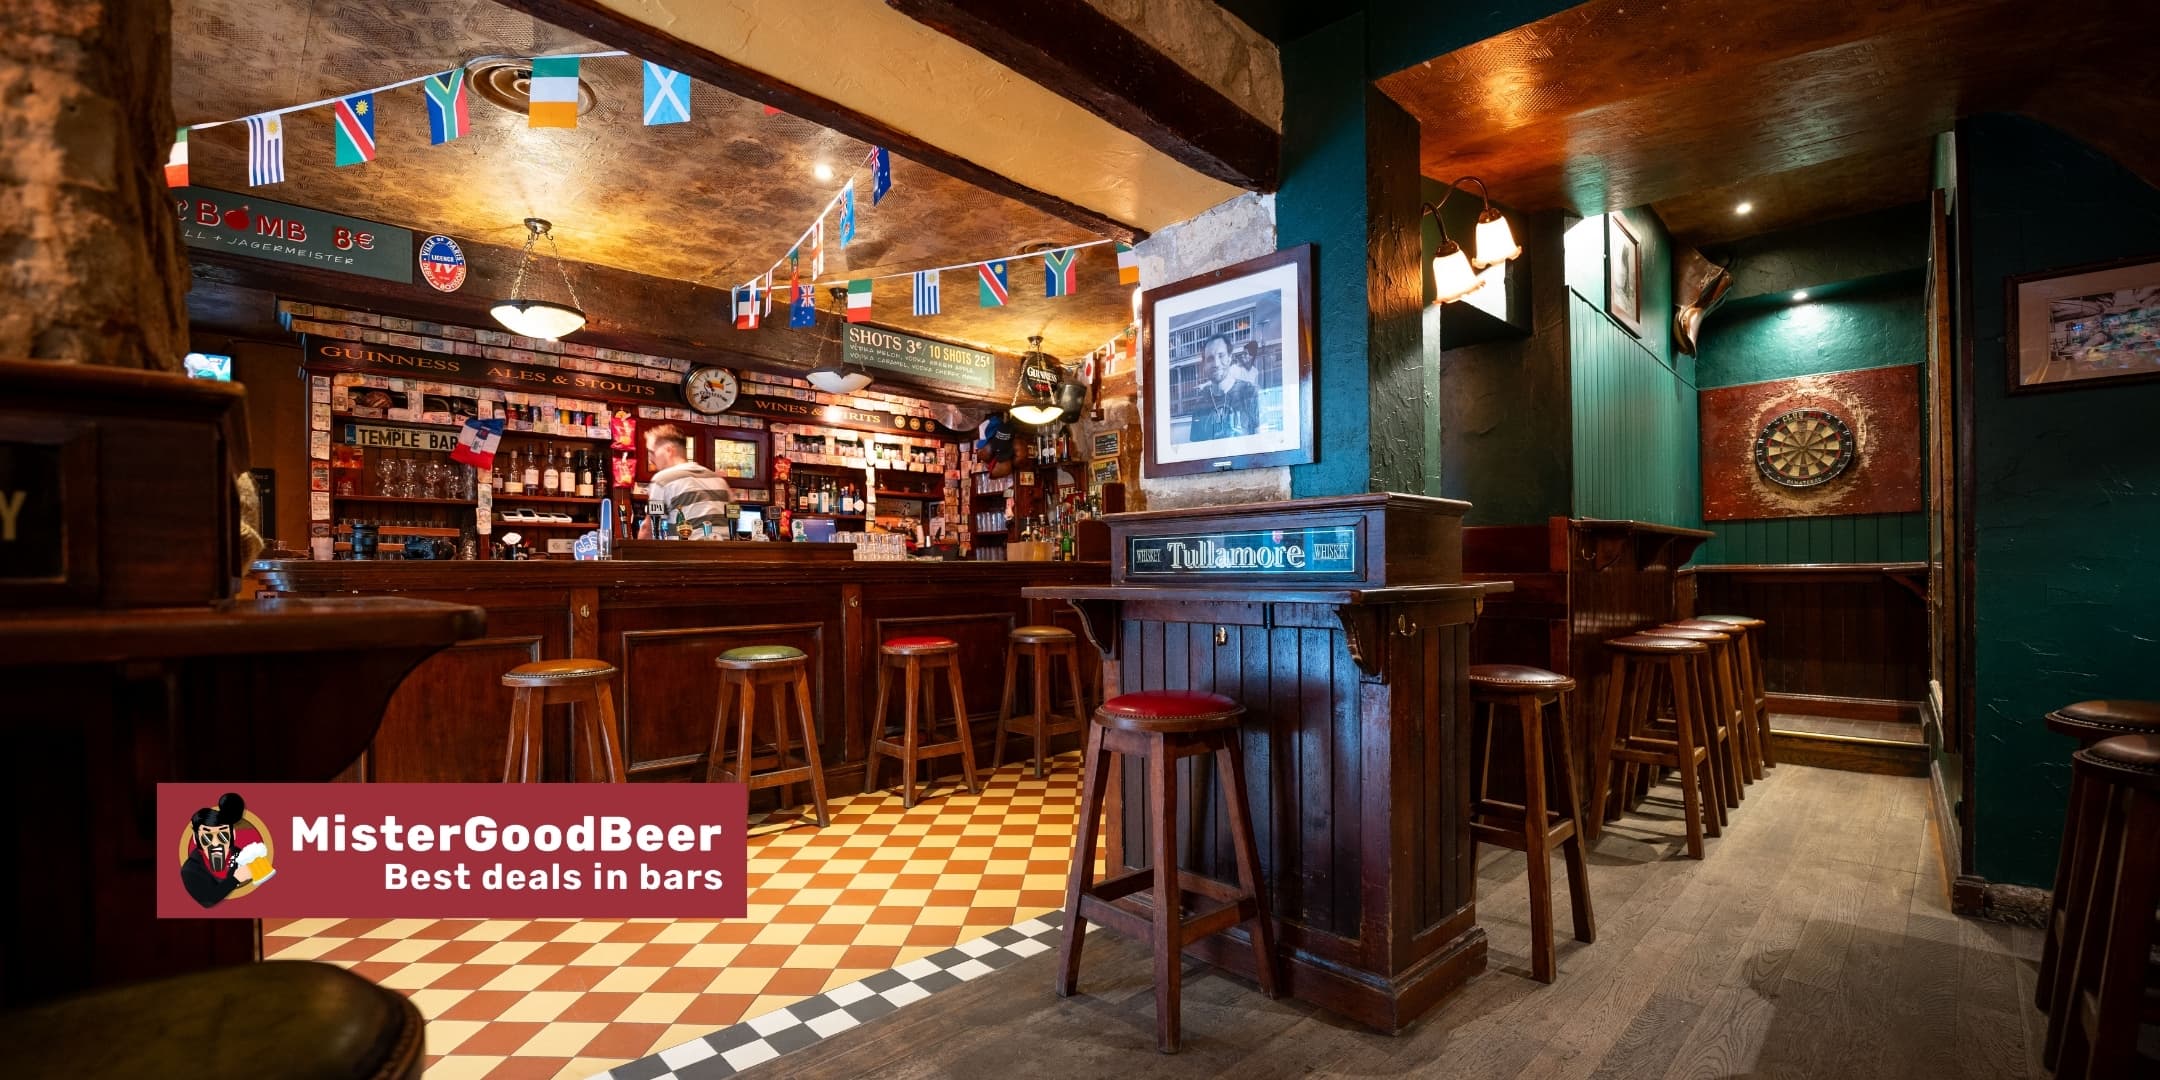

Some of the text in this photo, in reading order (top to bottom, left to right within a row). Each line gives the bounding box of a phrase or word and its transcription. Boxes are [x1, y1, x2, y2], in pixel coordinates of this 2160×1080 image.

[333, 225, 375, 251] 8€
[421, 239, 436, 256] VILLE
[447, 240, 463, 261] PARIS
[227, 238, 354, 266] JAGERMEISTER
[431, 254, 454, 263] LICENCE
[434, 262, 457, 274] IV
[849, 327, 902, 351] SHOTS
[929, 344, 941, 359] 10
[943, 347, 972, 365] SHOTS
[320, 346, 656, 395] GUINNESS ALES & STOUTS
[755, 400, 881, 423] WINES & IRITS
[359, 429, 420, 447] TEMPLE
[429, 434, 459, 450] BAR
[1136, 540, 1350, 569] WHISKEY Tullamore WHISKEY
